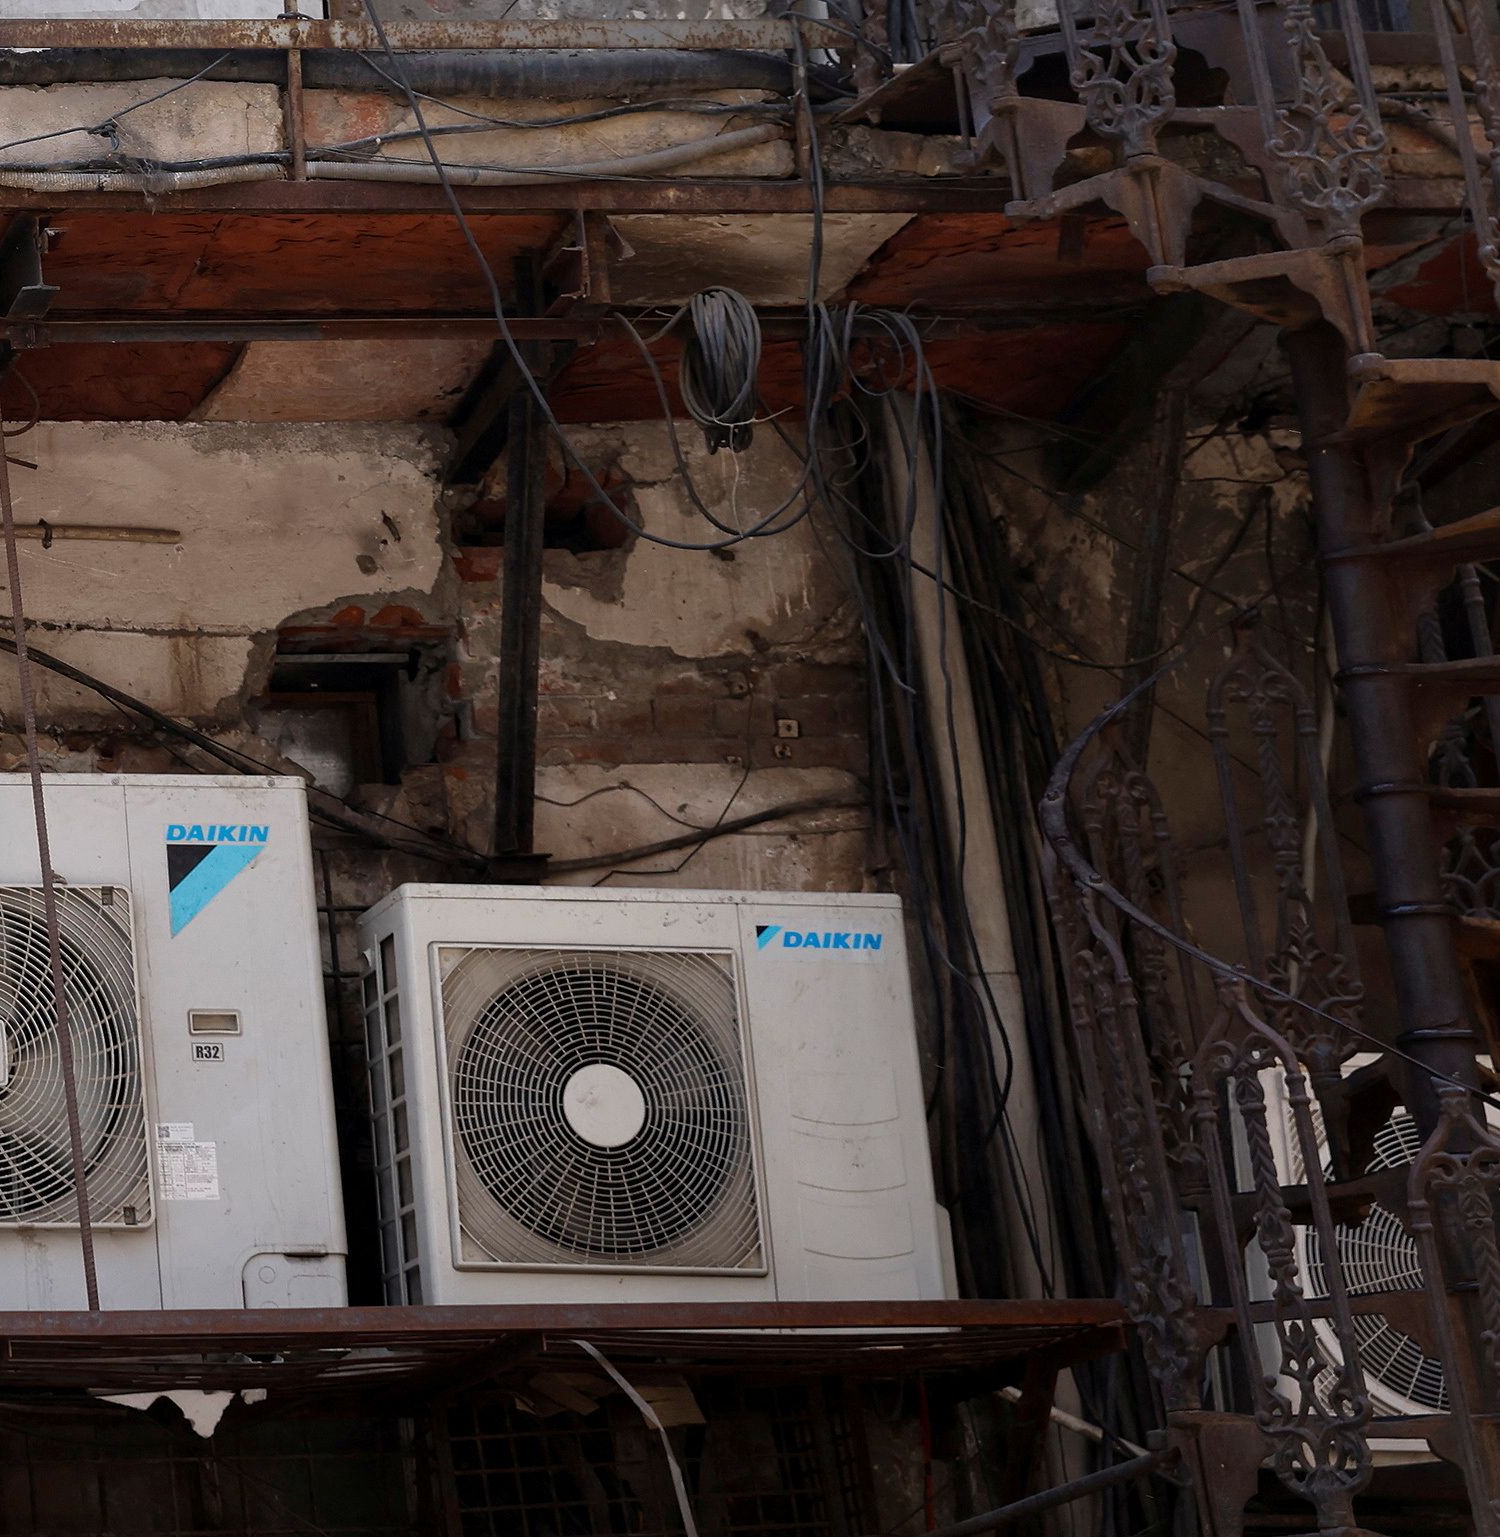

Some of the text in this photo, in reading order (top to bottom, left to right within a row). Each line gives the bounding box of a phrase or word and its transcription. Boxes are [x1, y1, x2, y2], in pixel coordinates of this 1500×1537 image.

[165, 824, 271, 844] DAIKIN
[782, 929, 884, 952] DAIKIN
[194, 1044, 221, 1061] R32
